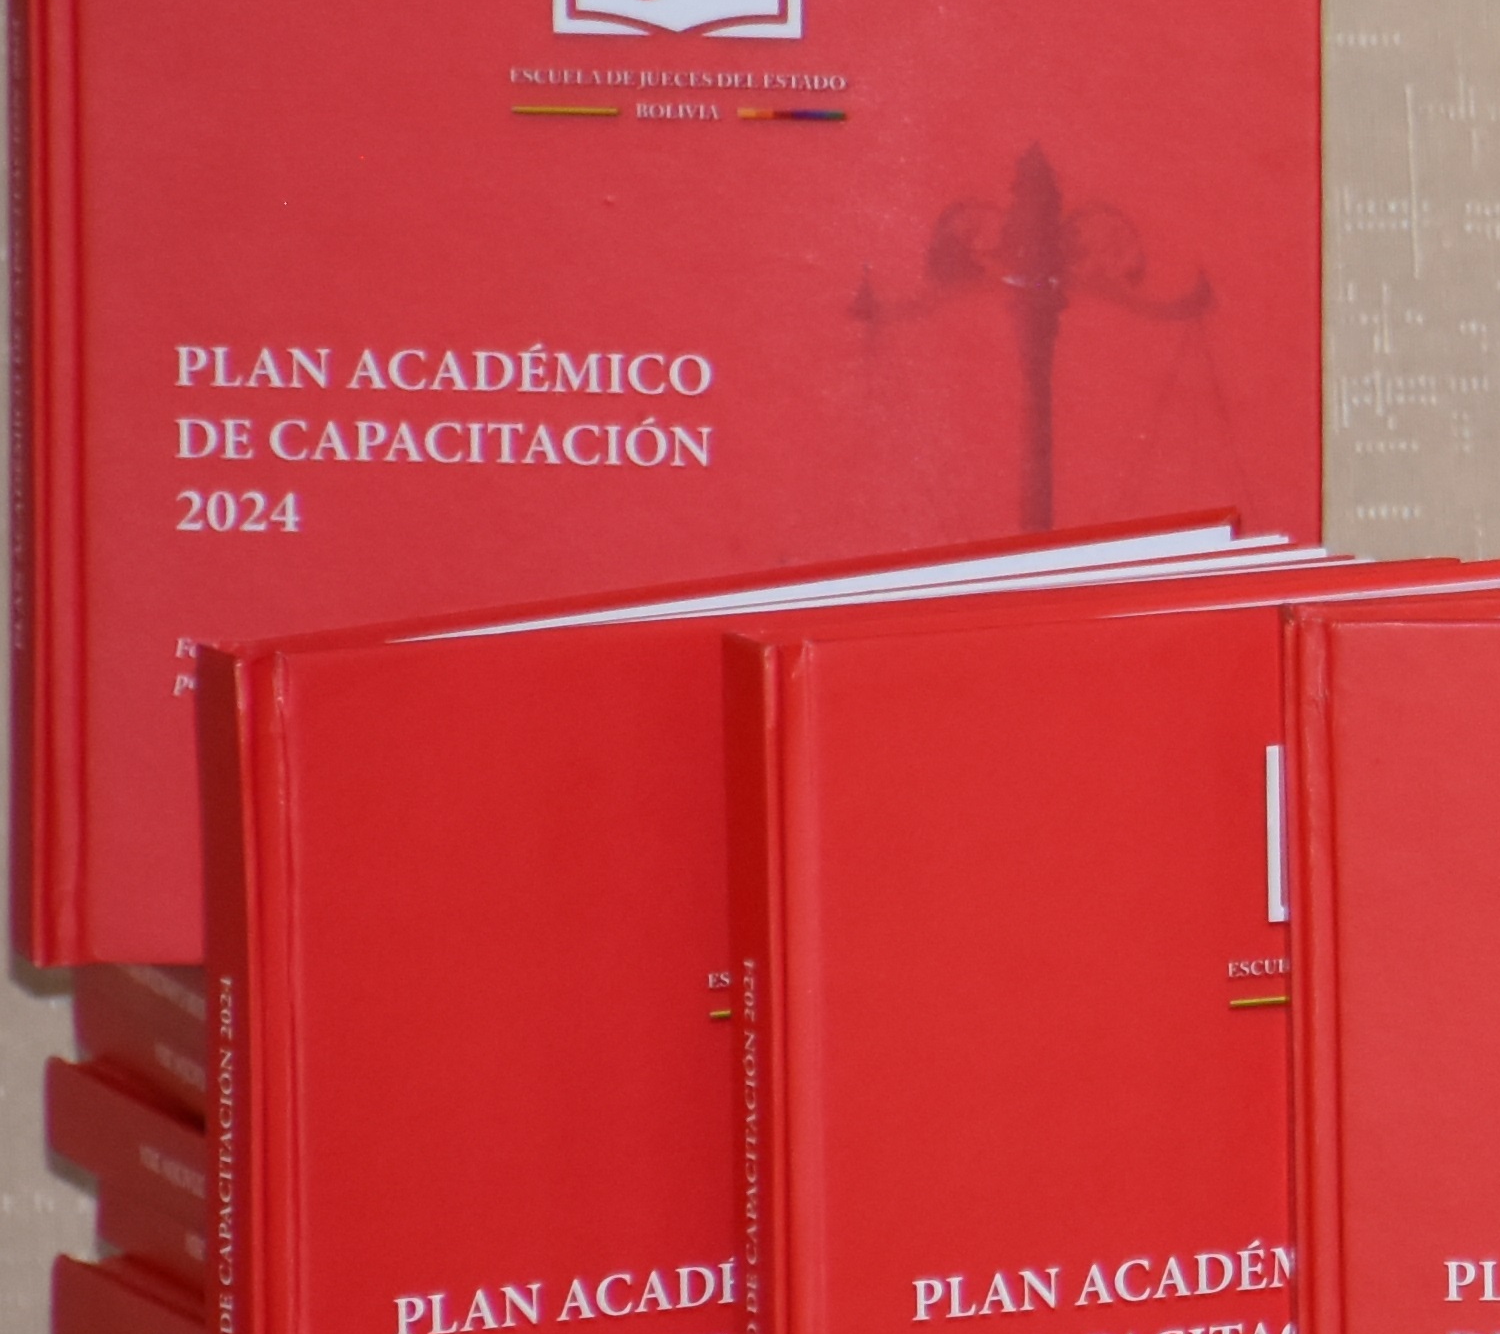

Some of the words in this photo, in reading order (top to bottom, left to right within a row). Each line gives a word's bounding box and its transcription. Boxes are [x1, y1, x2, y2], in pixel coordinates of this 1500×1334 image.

[510, 68, 602, 87] ESCUELA
[607, 72, 634, 86] DE
[637, 72, 711, 90] JUECES
[717, 74, 760, 88] DEL
[764, 74, 846, 91] ESTADO
[636, 103, 719, 119] BOLIVIA
[174, 345, 331, 389] PLAN
[347, 344, 712, 395] ACADÉMICO
[174, 419, 252, 460] DE
[269, 416, 712, 467] CAPACITACIÓN
[175, 491, 300, 532] 2024
[219, 976, 232, 1040] 2024
[217, 1048, 234, 1286] CAPACITACIÓN
[219, 1294, 233, 1334] DE
[912, 1267, 1059, 1322] PLAN
